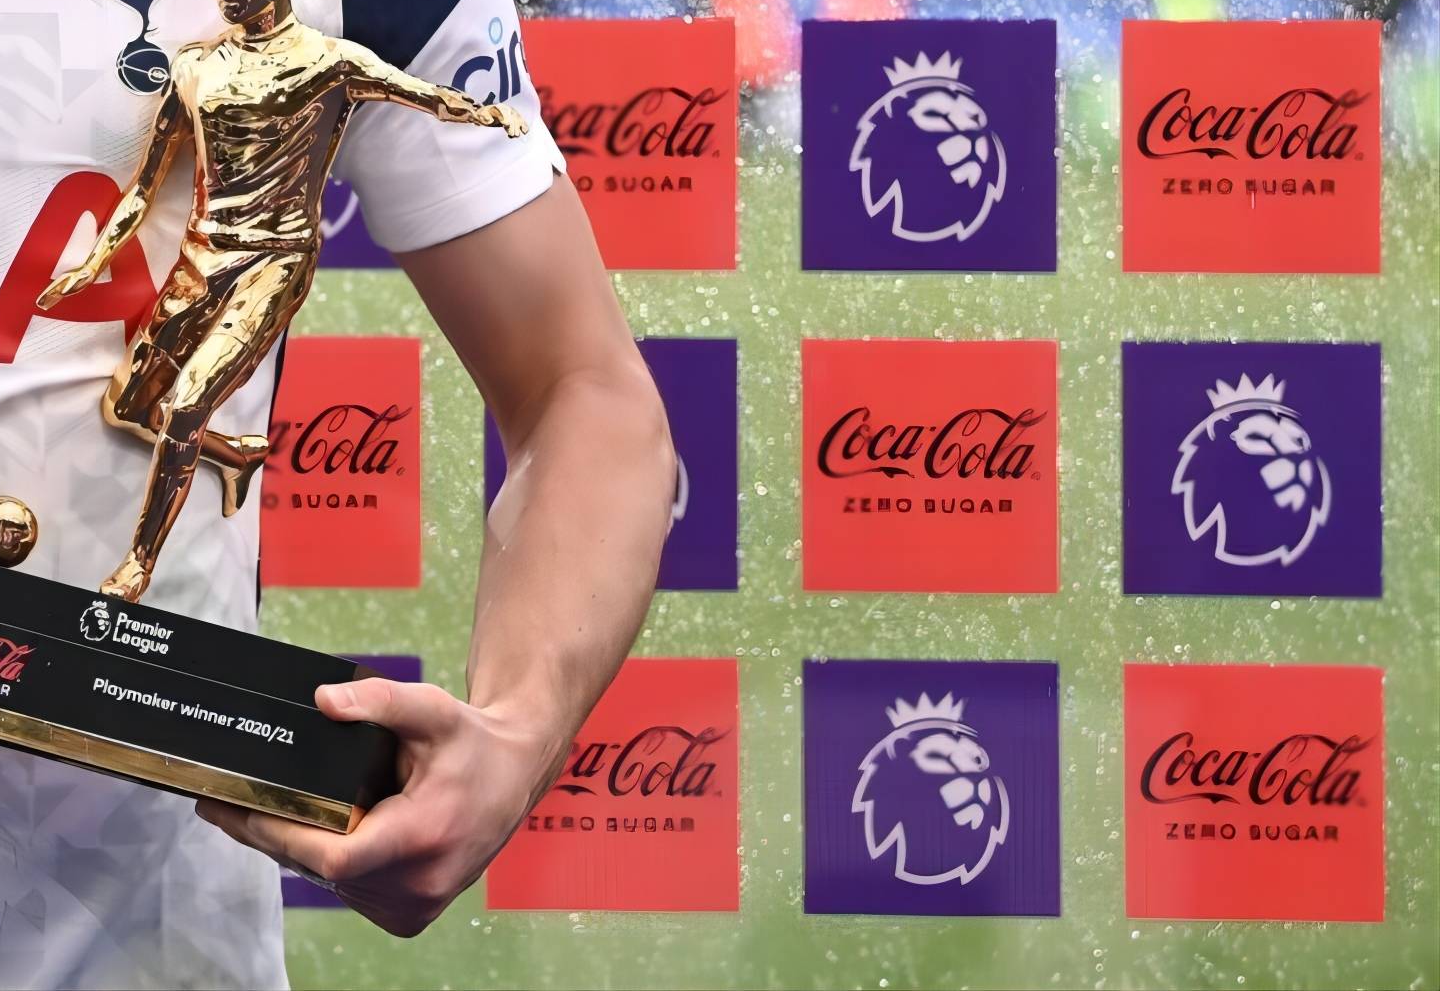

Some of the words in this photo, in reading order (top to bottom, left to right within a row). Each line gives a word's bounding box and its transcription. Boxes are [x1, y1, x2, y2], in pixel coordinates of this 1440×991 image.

[539, 87, 731, 160] ca-Cola
[1136, 88, 1371, 162] Coca-Cola
[605, 176, 693, 193] SUGAR
[1163, 178, 1235, 197] ZERO
[1245, 178, 1337, 197] SUGAR
[816, 407, 1048, 481] Coca-Cola
[291, 493, 379, 510] SUGAR
[844, 498, 914, 515] ZERO
[924, 498, 1014, 515] SUGAR
[112, 625, 169, 655] League
[115, 613, 174, 640] Premier
[92, 677, 178, 713] Playmaker
[180, 701, 236, 728] winner
[235, 716, 295, 746] 2020/21
[553, 725, 733, 798] a-Cola
[1139, 732, 1374, 809] Coca-Cola
[527, 816, 595, 834] ZERO
[606, 816, 696, 834] SUGAR
[1167, 823, 1238, 843] ZERO
[1250, 823, 1340, 843] SUGAR
